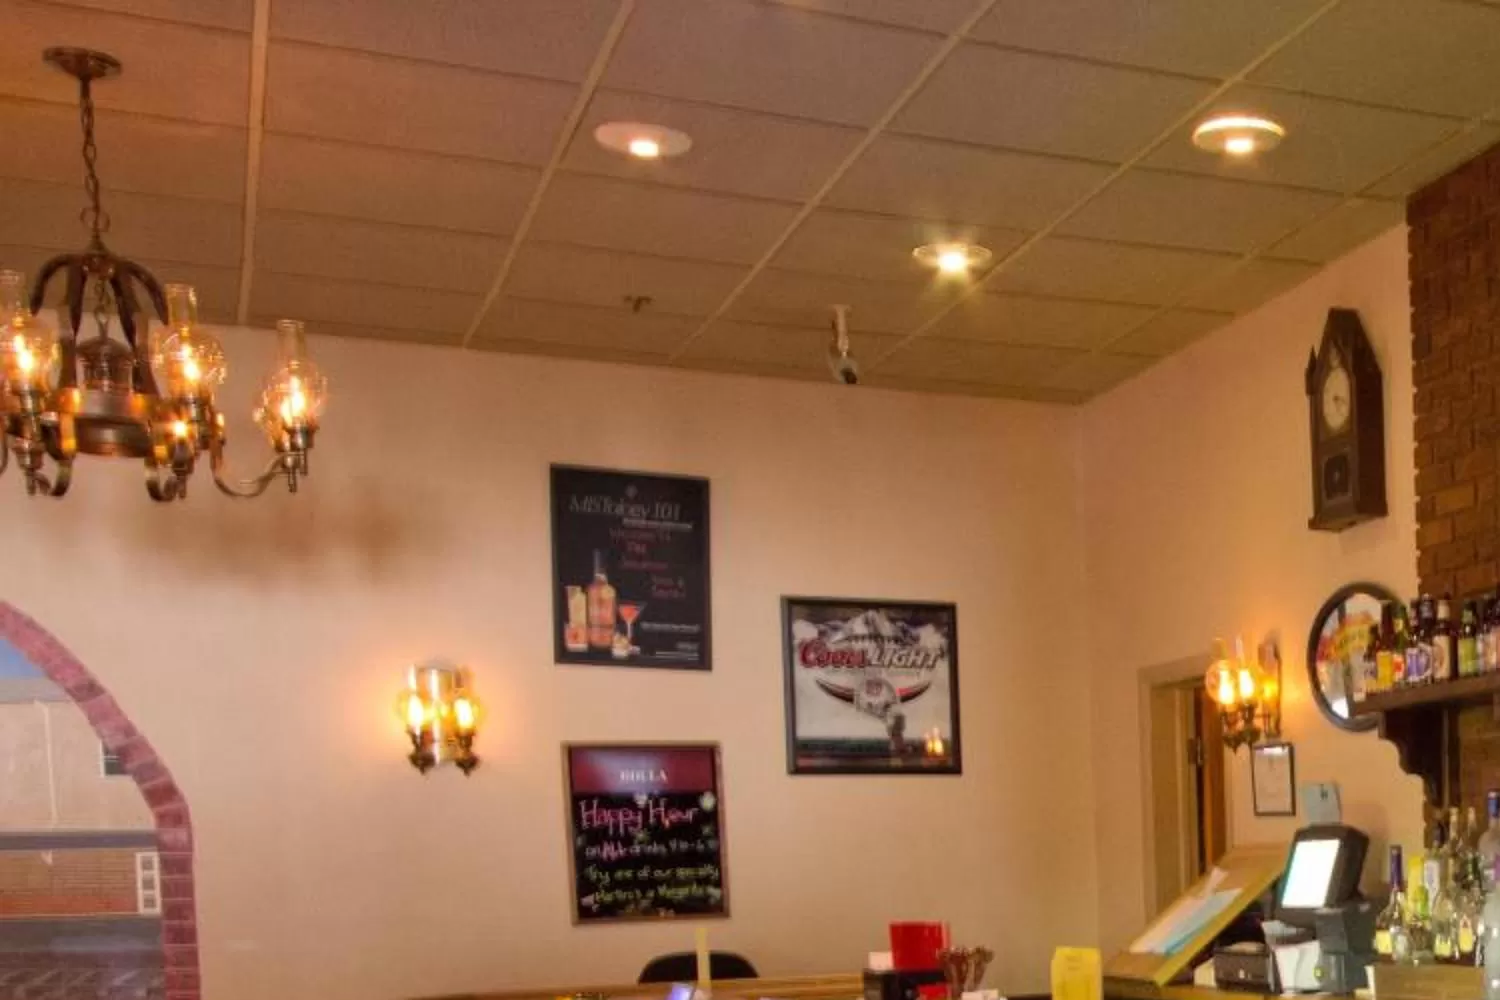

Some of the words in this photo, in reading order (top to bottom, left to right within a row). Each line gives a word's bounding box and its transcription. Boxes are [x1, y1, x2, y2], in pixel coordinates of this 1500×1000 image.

[798, 639, 867, 669] Coors
[867, 646, 946, 669] LIGHT
[580, 798, 643, 837] Happy
[649, 797, 699, 828] Hour
